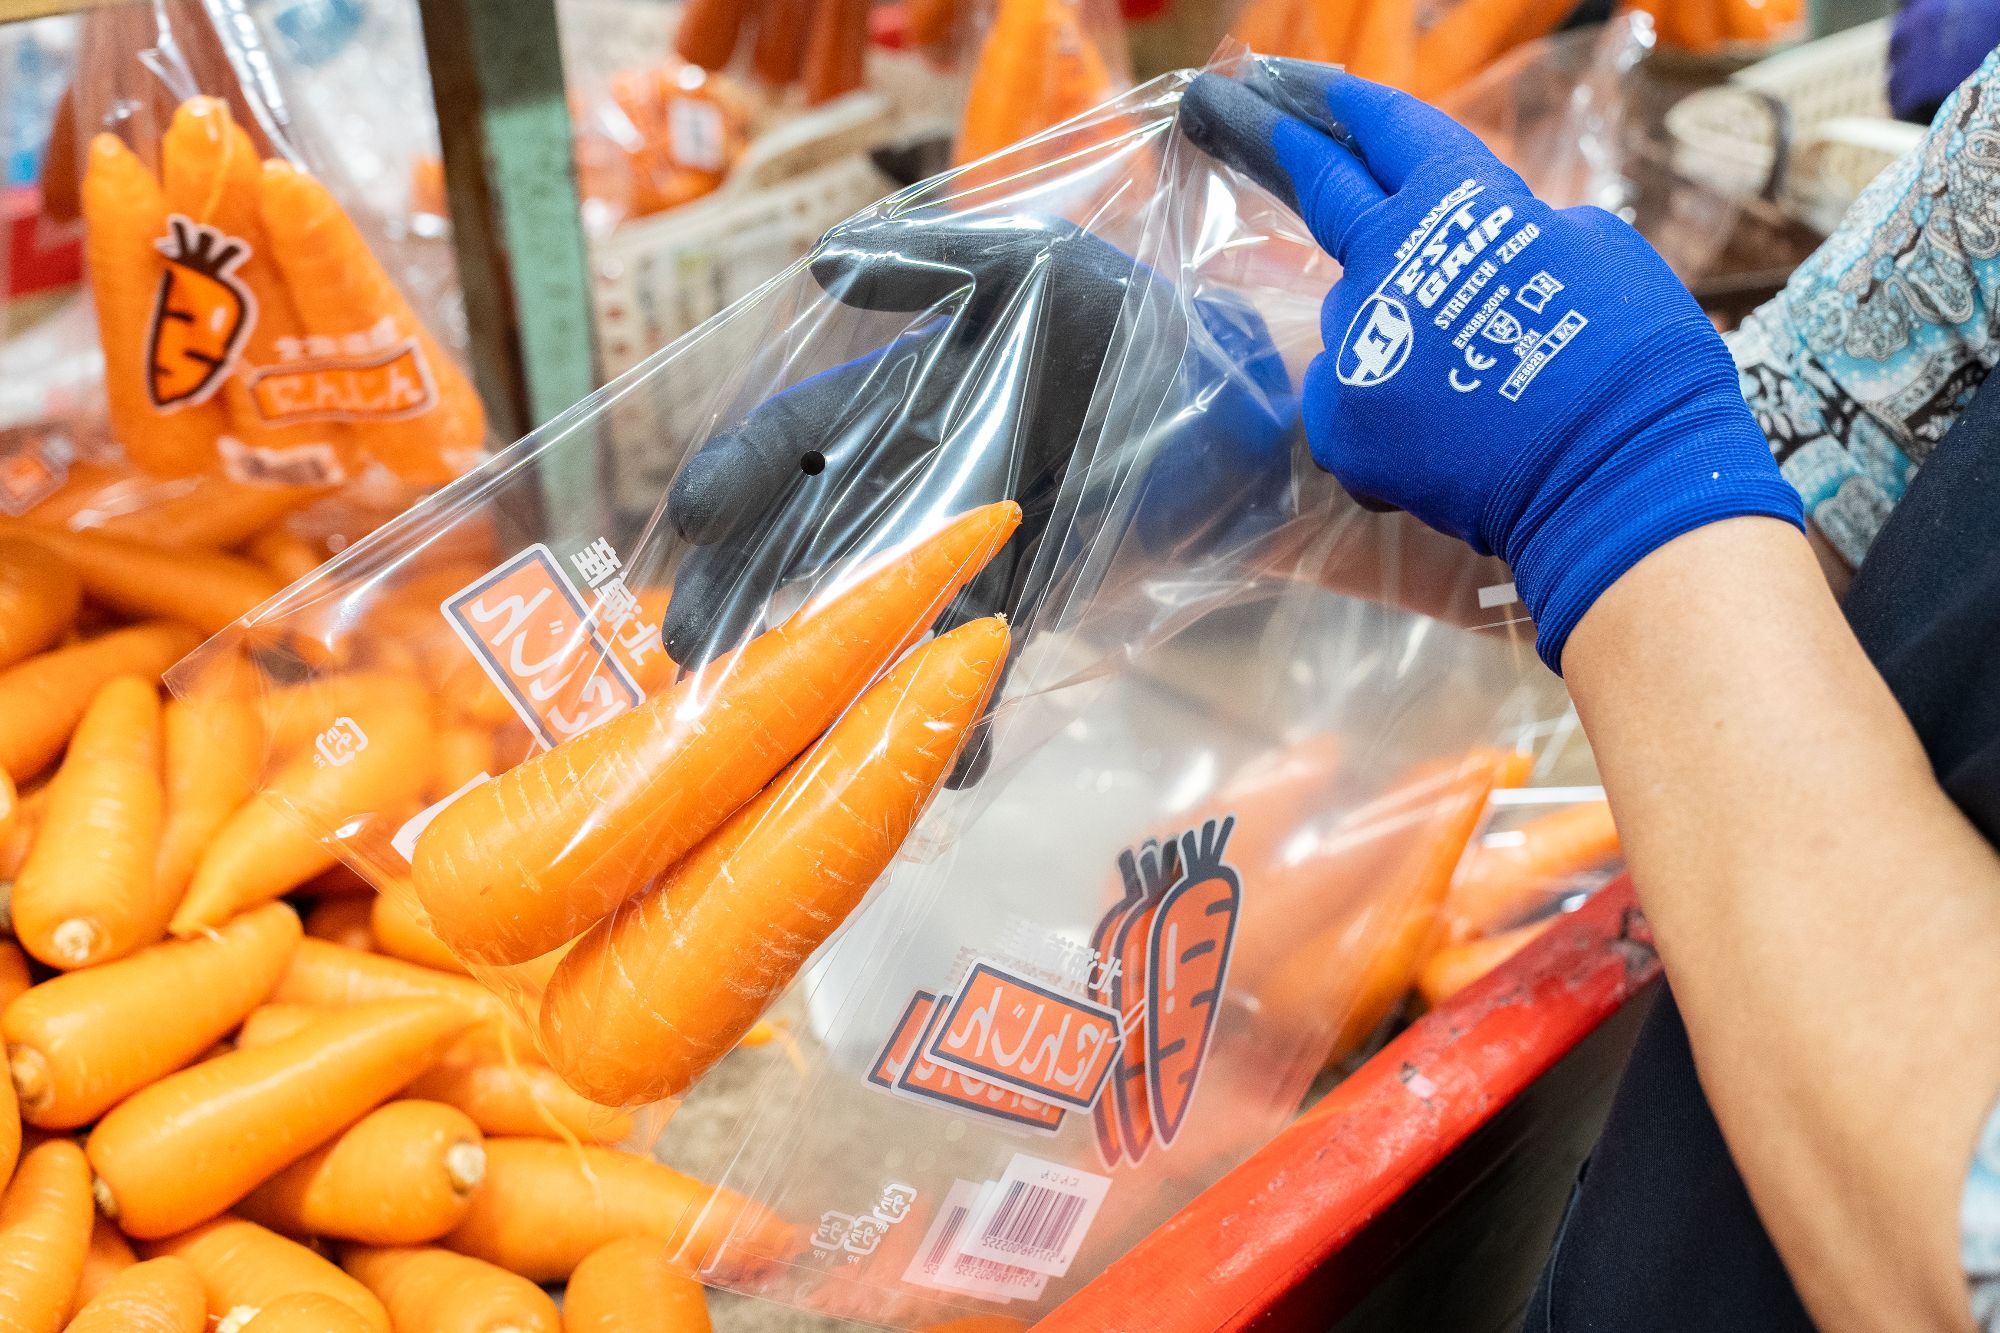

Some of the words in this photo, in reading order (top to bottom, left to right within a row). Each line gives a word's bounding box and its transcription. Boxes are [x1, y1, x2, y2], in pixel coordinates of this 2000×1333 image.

[1416, 205, 1514, 308] GRIP
[1434, 261, 1498, 330] STRETCH
[1496, 223, 1541, 264] ZERO
[1452, 285, 1511, 350] EN388:2016
[1512, 330, 1543, 358] 2121
[1448, 344, 1497, 393] CE
[1512, 350, 1548, 389] PE802D
